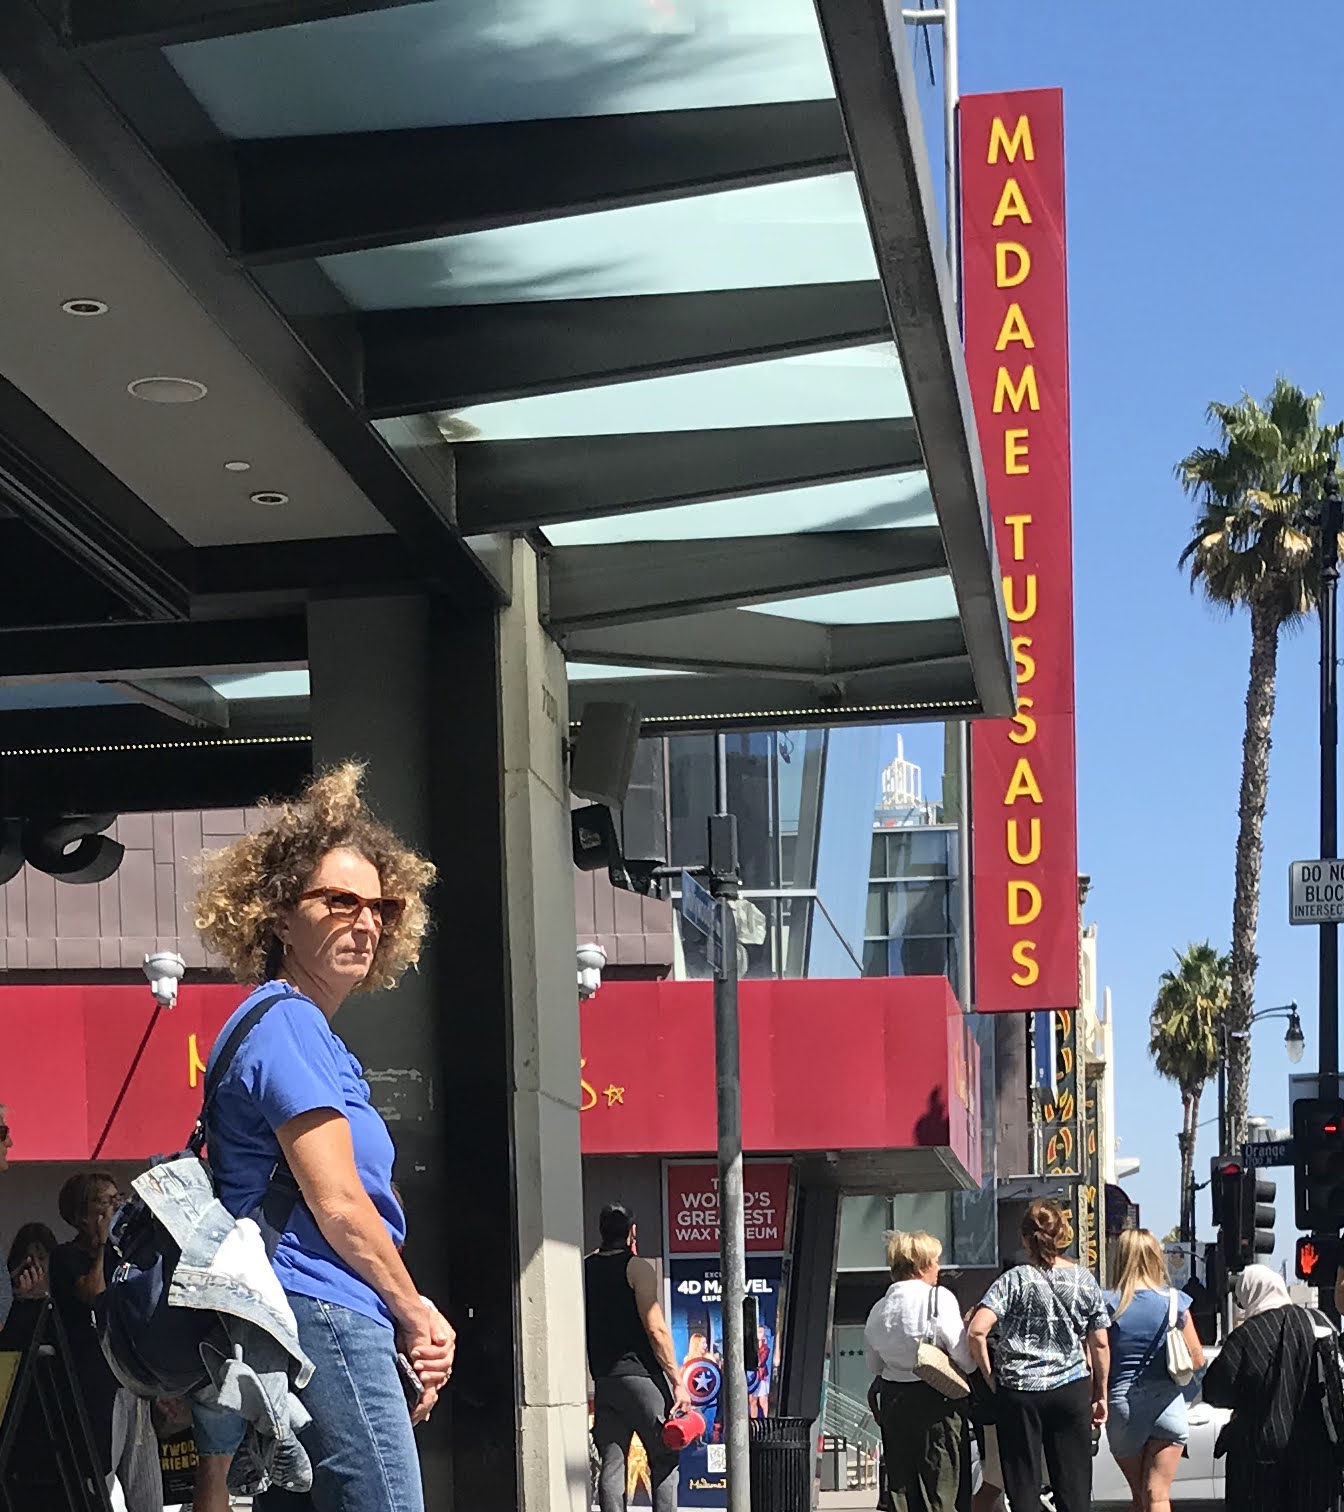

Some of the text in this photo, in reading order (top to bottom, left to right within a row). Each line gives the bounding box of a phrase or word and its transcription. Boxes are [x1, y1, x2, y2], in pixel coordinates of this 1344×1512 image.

[987, 114, 1043, 987] MADAME TUSSAUDS
[1301, 865, 1321, 882] DO
[1246, 1144, 1285, 1161] Orange
[680, 1192, 771, 1208] WOD'S
[677, 1210, 775, 1226] GREEST
[676, 1229, 711, 1240] WAX
[677, 1281, 701, 1294] 4D
